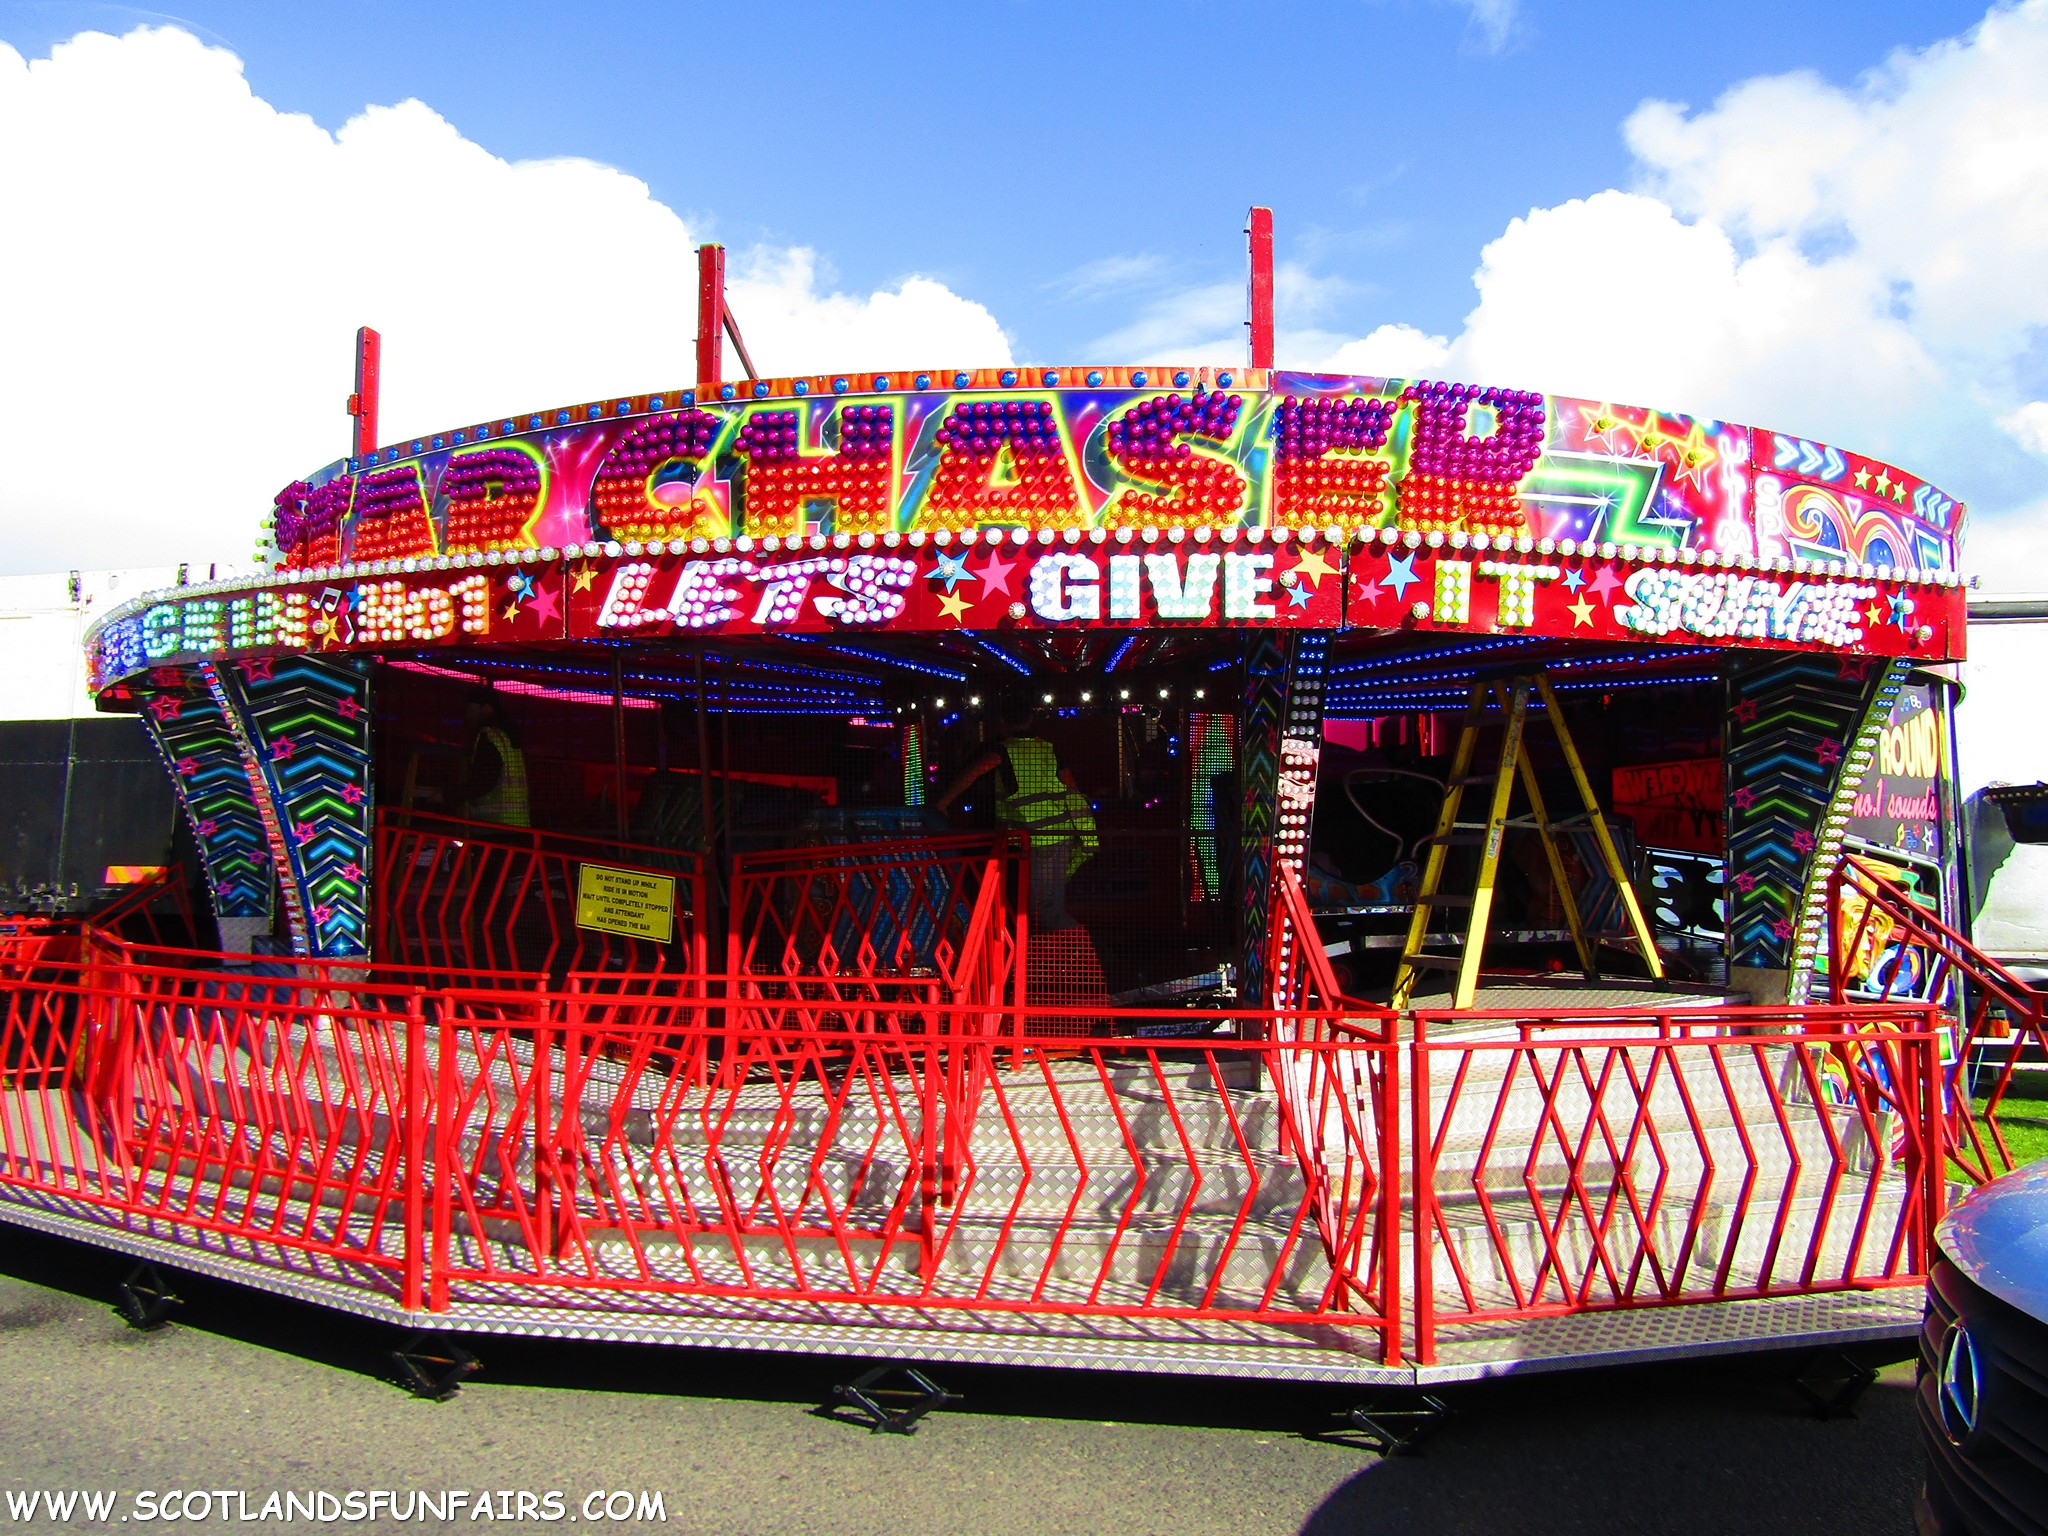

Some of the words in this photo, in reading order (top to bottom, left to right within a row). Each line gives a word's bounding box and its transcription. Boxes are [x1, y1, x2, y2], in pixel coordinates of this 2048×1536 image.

[592, 381, 1545, 545] CHASER
[597, 556, 917, 628] LETS
[1030, 552, 1276, 620] GIVE
[1433, 558, 1561, 627] IT
[1888, 784, 1937, 819] sounds
[616, 877, 631, 885] STAND
[641, 880, 656, 889] WHILE
[603, 885, 614, 893] RIDE
[628, 888, 648, 898] MOTION
[583, 892, 595, 900] WAIT
[596, 894, 610, 903] UNTIL
[612, 897, 643, 909] COMPLETELY
[645, 904, 668, 912] STOPPED
[615, 908, 645, 919] ATTENDANT
[608, 917, 627, 927] OPENED
[629, 920, 639, 928] THE
[640, 922, 650, 930] BAR
